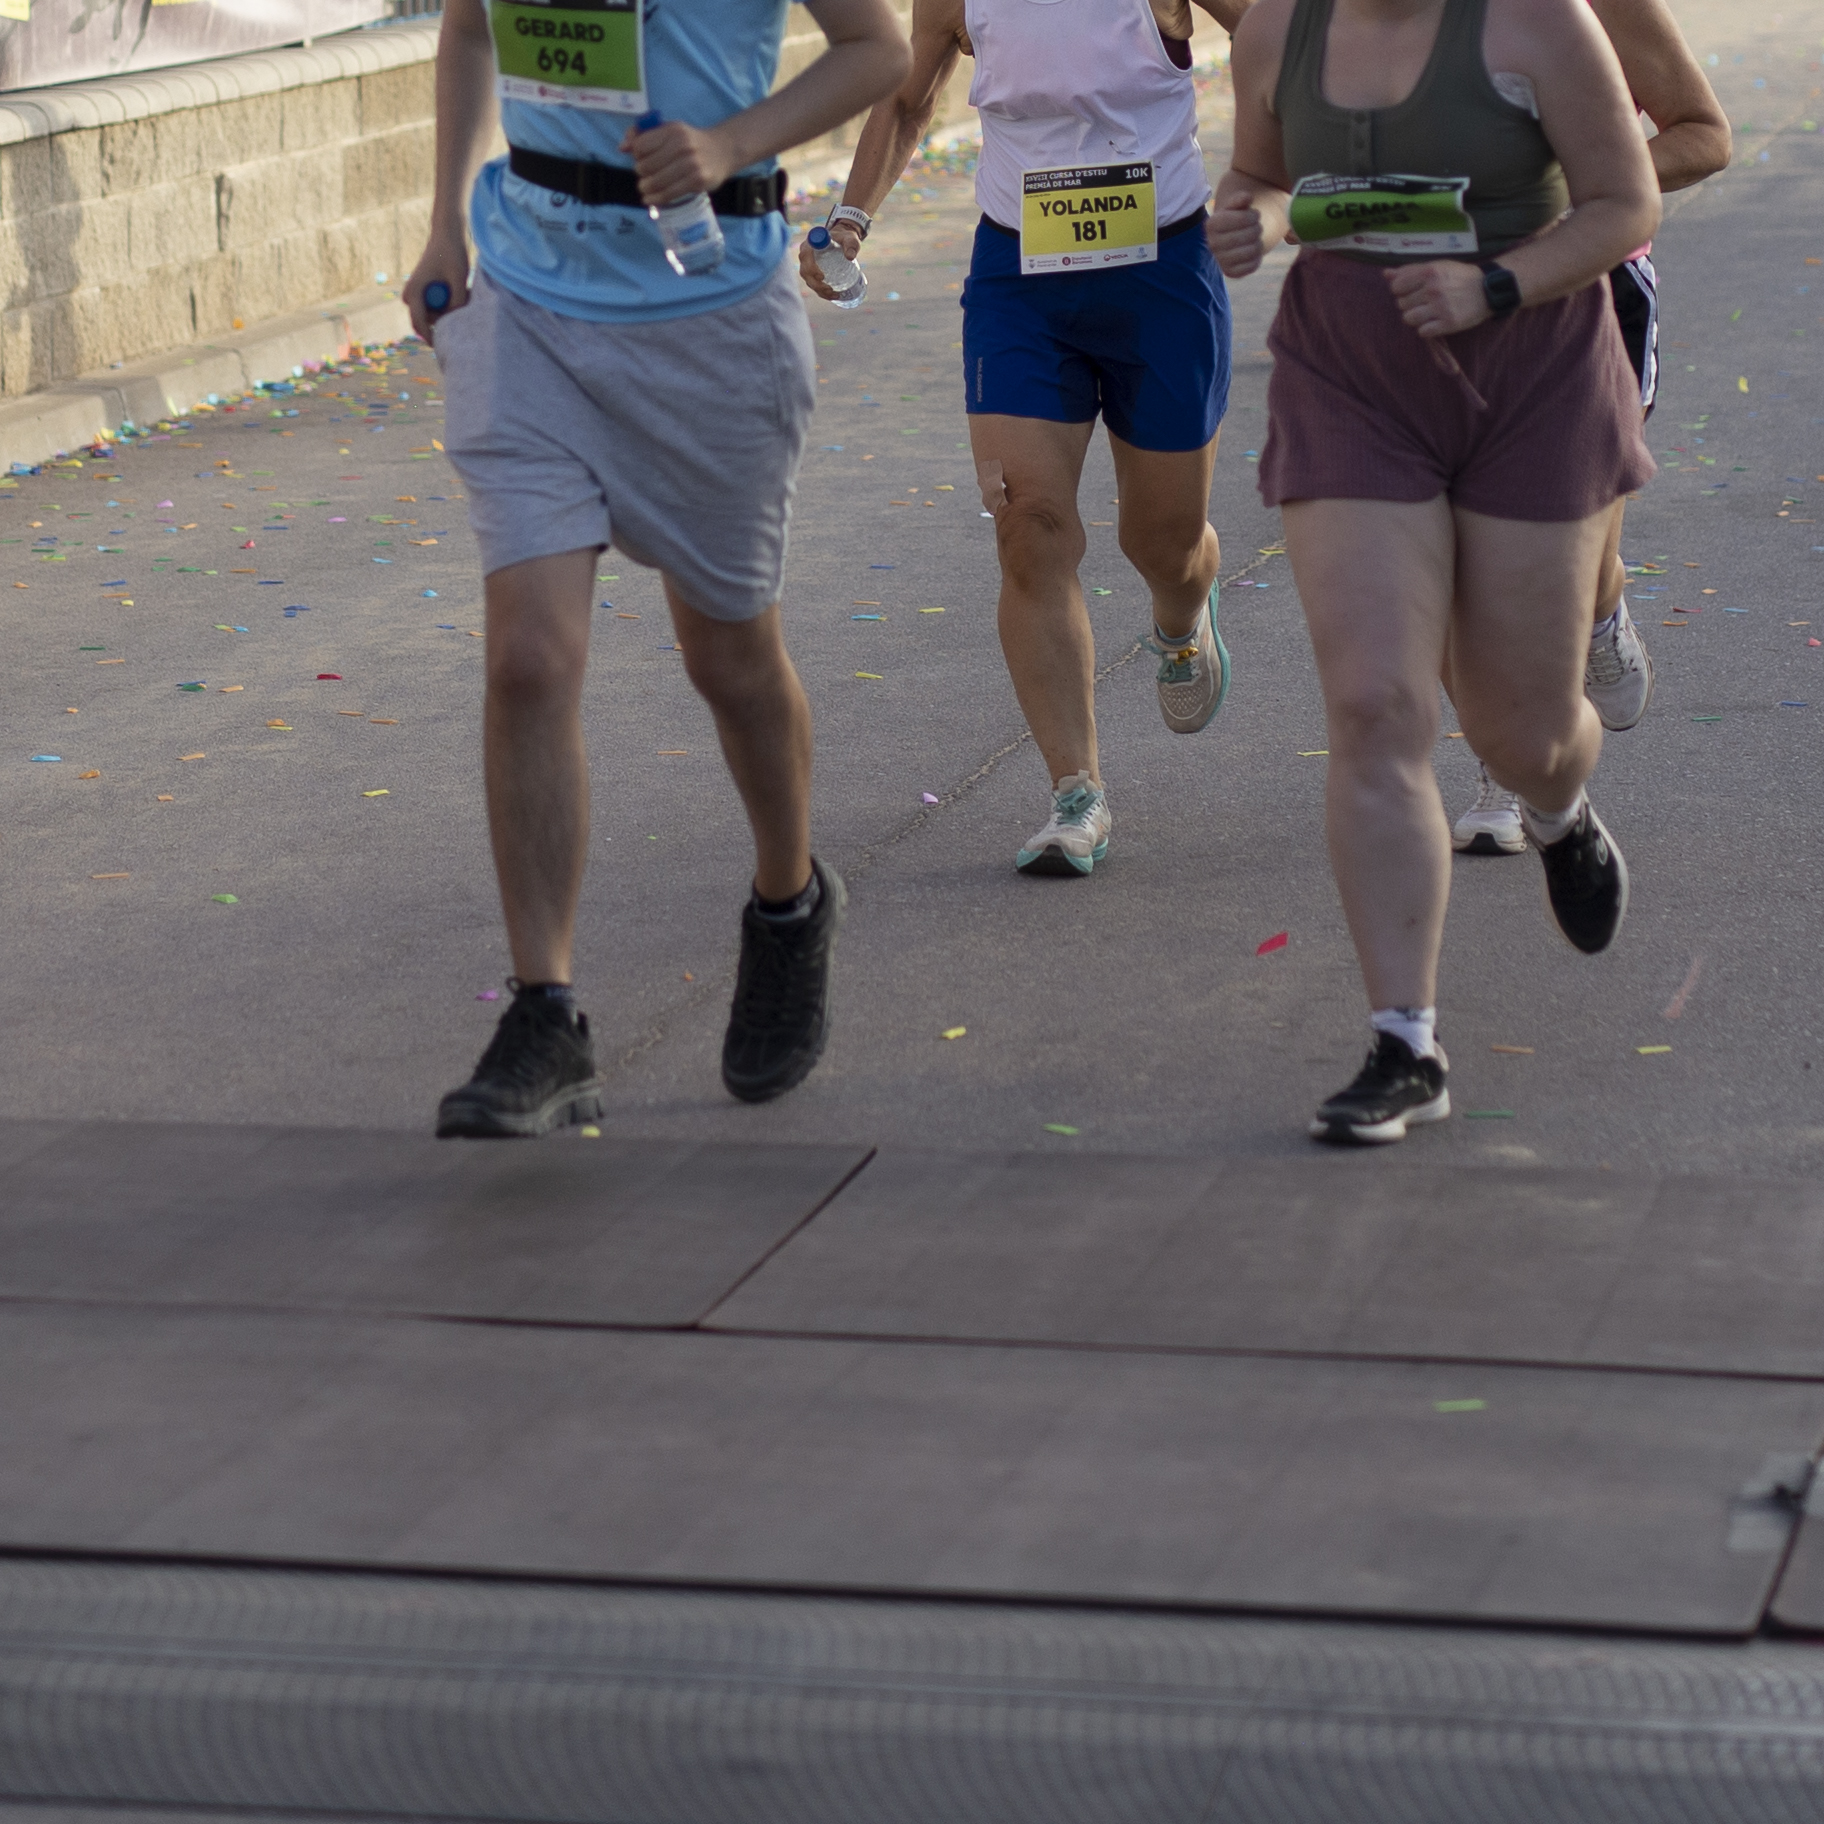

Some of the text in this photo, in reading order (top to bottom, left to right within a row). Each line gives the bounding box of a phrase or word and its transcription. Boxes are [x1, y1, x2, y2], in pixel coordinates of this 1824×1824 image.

[515, 17, 605, 43] GERARD
[537, 47, 586, 76] 694
[1049, 171, 1074, 180] CURSA
[1076, 168, 1108, 177] D'ESTIU
[1125, 166, 1149, 179] 10K
[1053, 180, 1063, 188] DE
[1064, 178, 1082, 187] MAR
[1039, 194, 1138, 218] YOLANDA
[1072, 219, 1107, 243] 181
